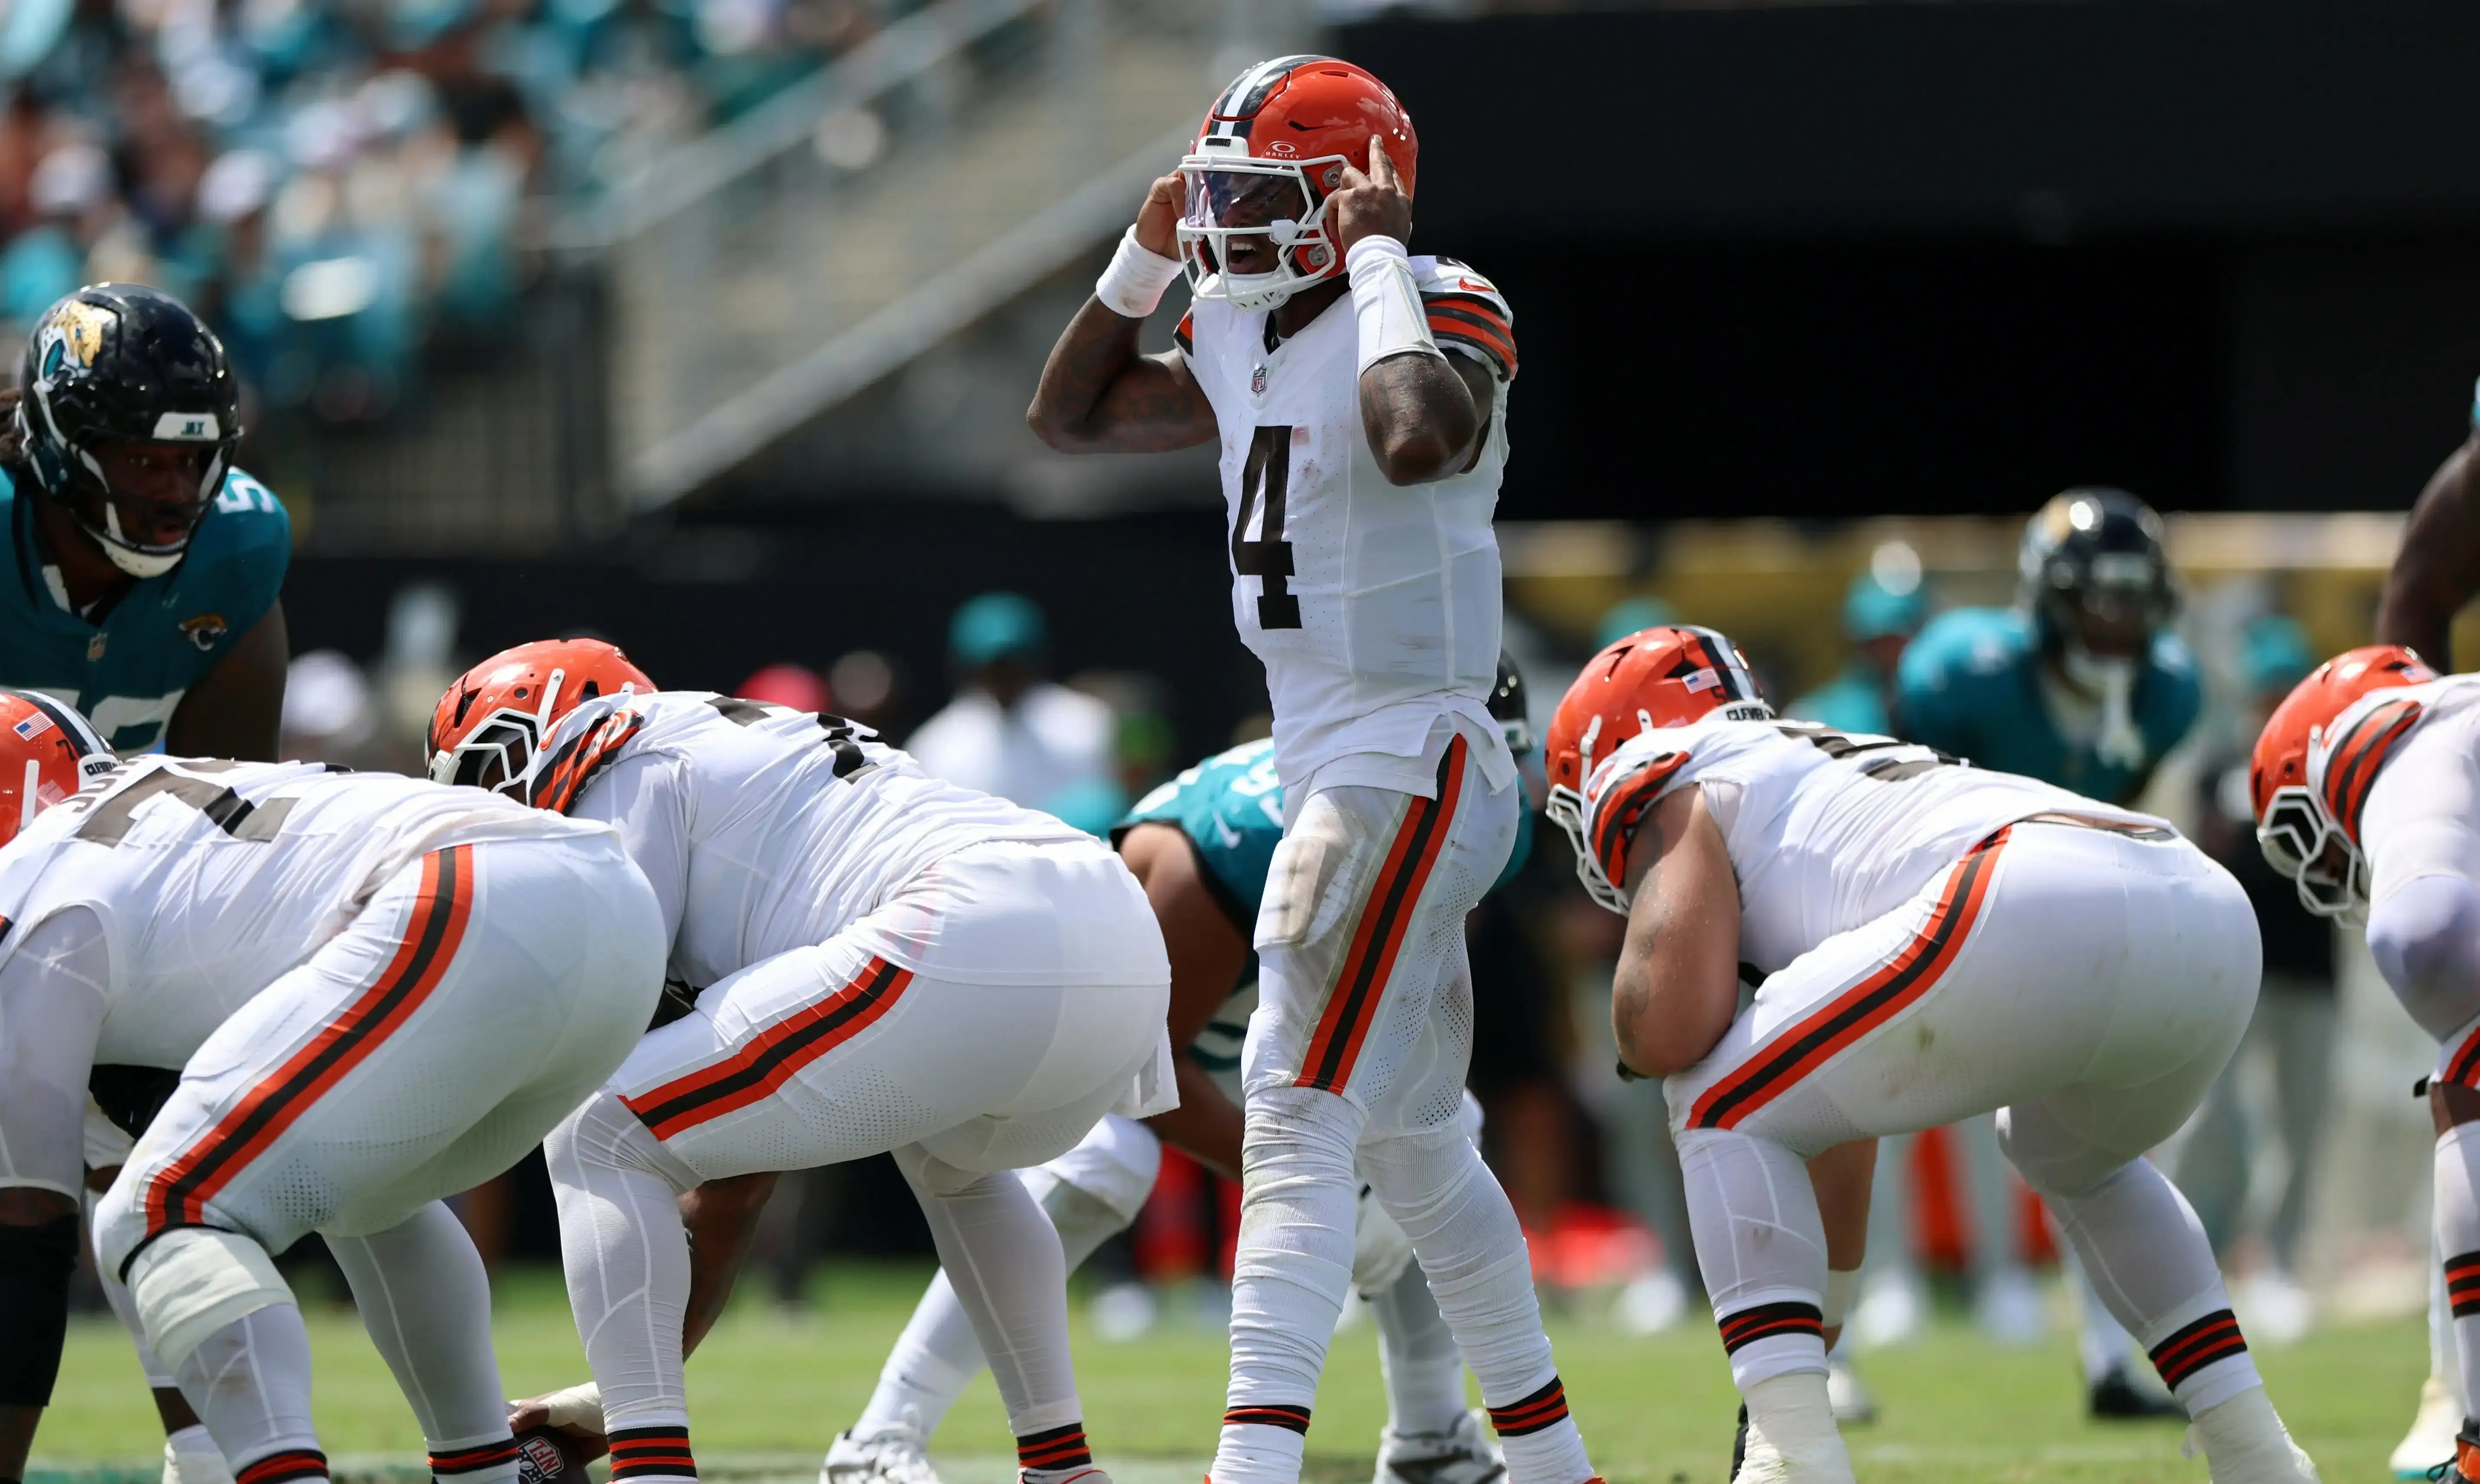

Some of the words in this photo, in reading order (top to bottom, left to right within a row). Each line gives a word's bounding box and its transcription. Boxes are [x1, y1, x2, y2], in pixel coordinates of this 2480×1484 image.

[1265, 151, 1300, 159] OAKLEY
[1231, 425, 1302, 630] 4
[56, 739, 76, 762] 7
[529, 1440, 559, 1473] NFL
